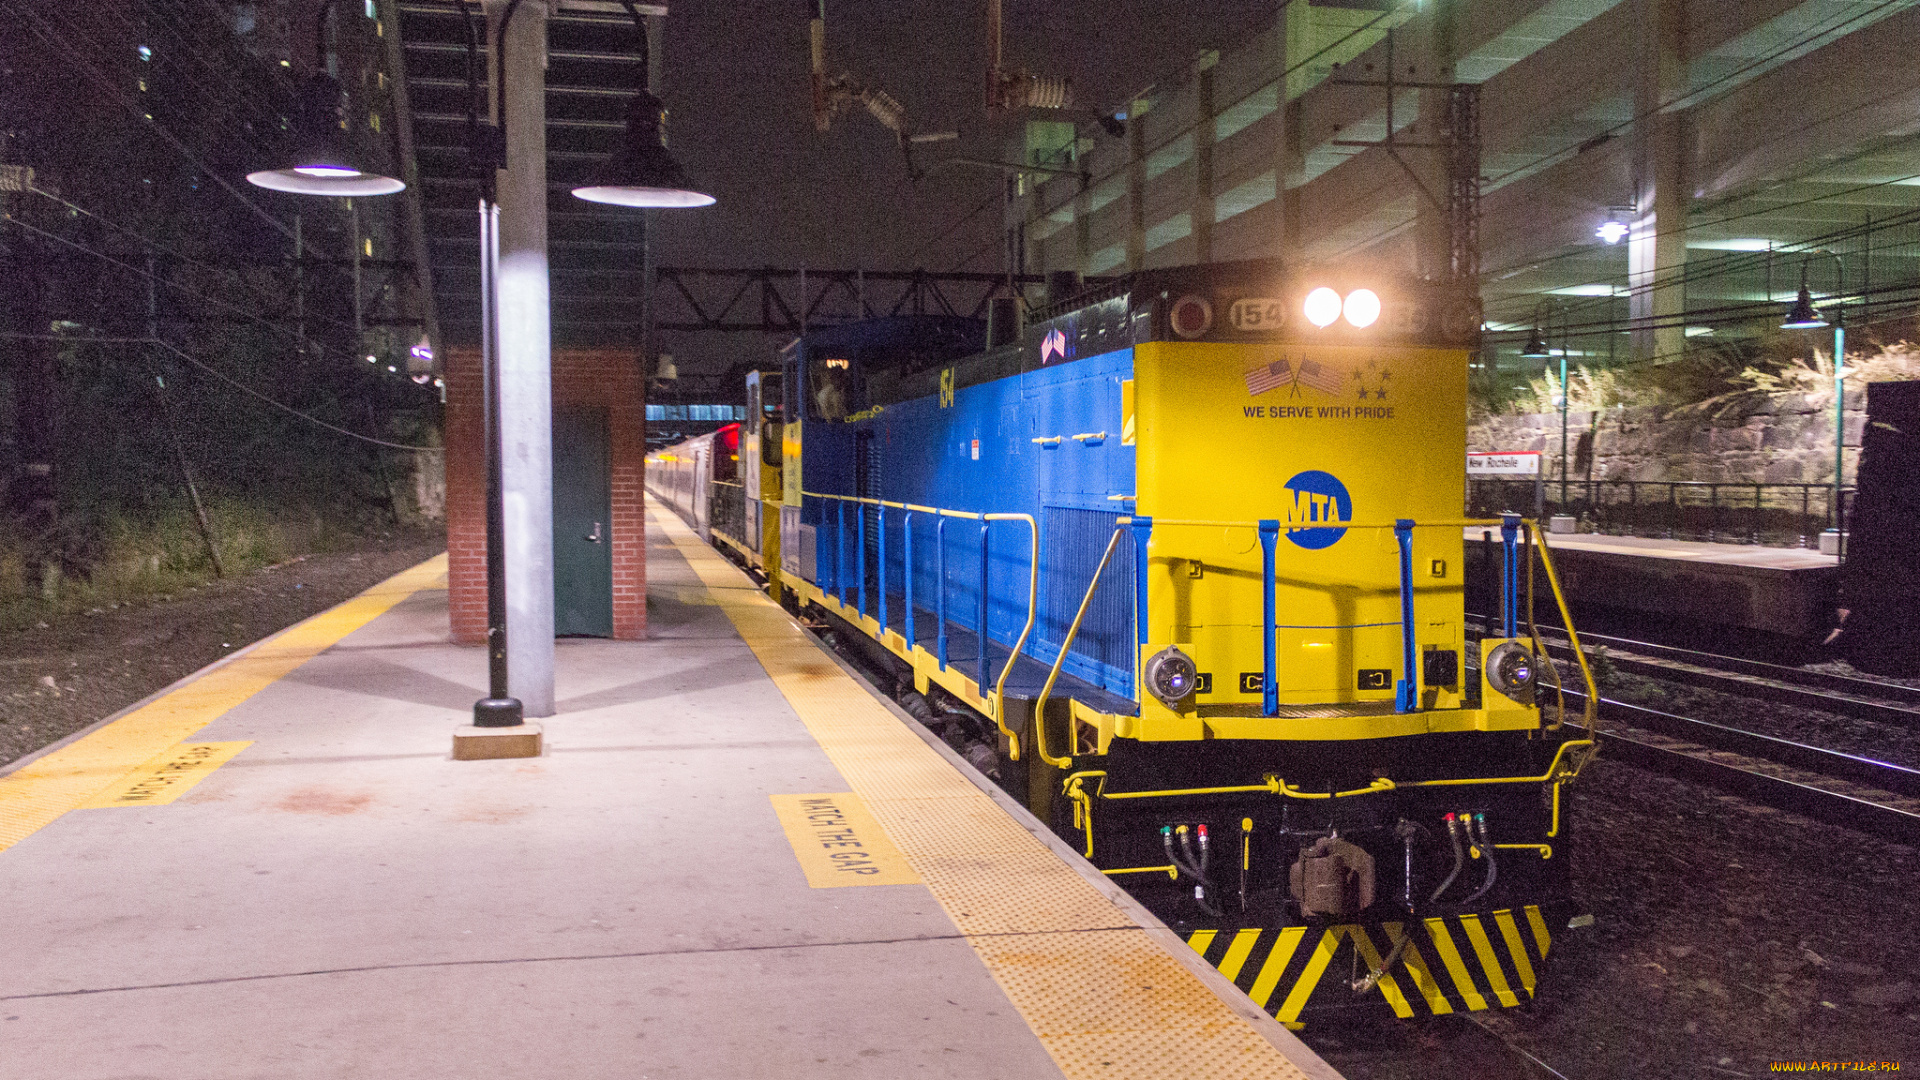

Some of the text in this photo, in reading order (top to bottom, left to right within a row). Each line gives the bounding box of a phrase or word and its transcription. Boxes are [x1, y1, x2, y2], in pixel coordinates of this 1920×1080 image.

[1234, 303, 1281, 326] 154
[940, 366, 955, 408] 154
[1243, 406, 1395, 418] WE SERVE WITH PRIDE
[1283, 487, 1340, 534] MTA
[798, 798, 880, 875] WATCH THE GAP
